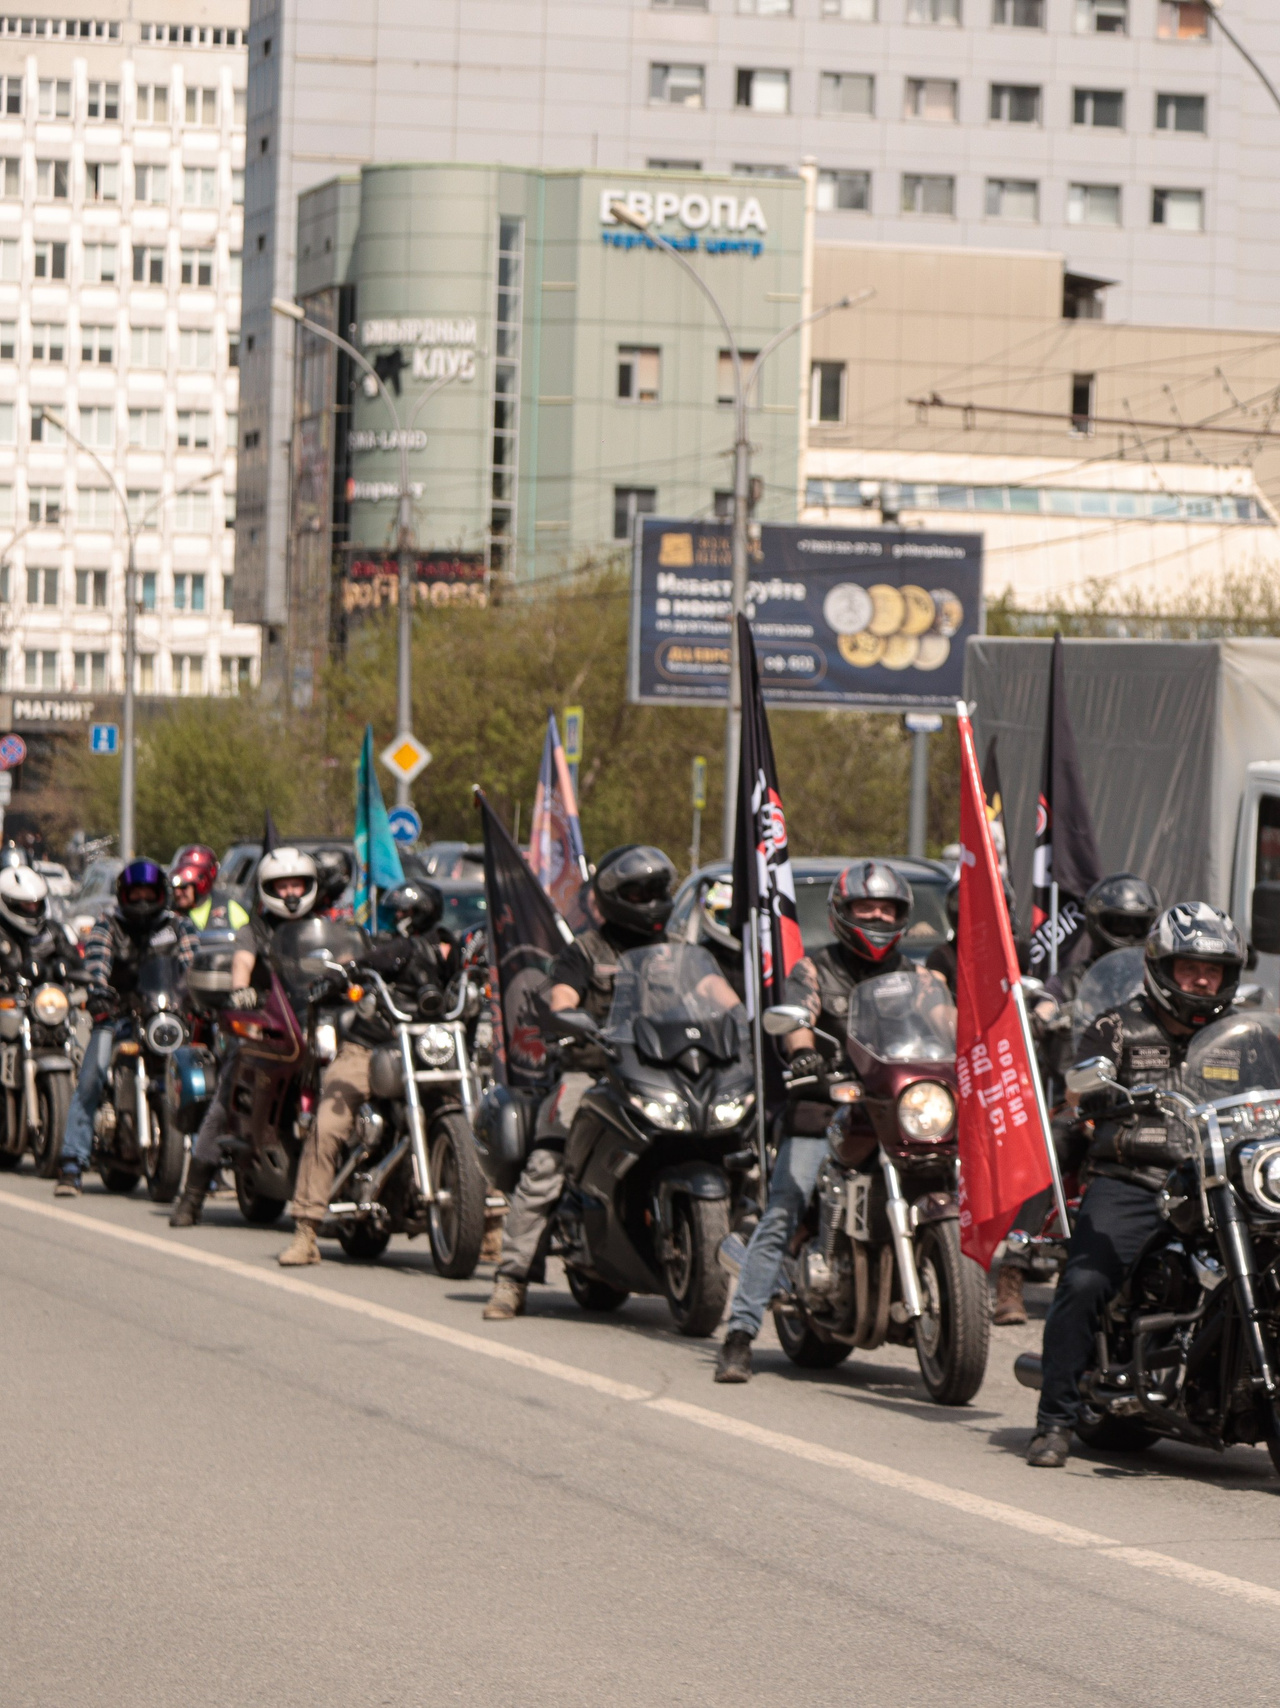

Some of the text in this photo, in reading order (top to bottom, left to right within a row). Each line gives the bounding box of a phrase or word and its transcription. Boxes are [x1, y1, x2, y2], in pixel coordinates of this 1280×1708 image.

[600, 188, 769, 233] ЕВРОПА
[412, 349, 476, 381] КЛУБ
[14, 699, 94, 720] МАГНИТ
[1029, 901, 1086, 965] SIBIR
[997, 1038, 1028, 1128] ОРДЕНА
